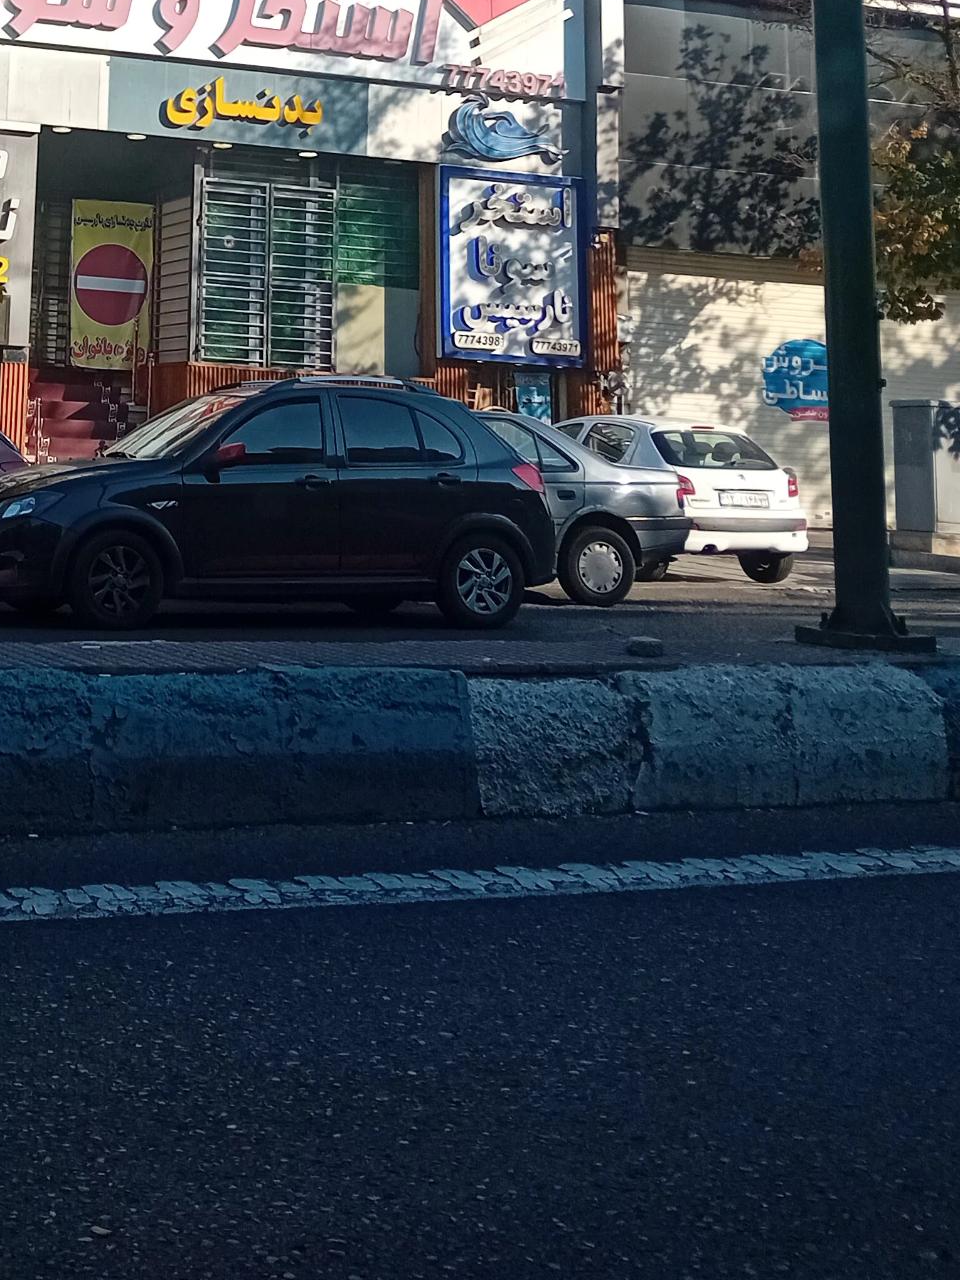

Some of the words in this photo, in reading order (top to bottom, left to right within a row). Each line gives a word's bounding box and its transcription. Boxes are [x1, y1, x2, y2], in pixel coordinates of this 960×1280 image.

[442, 64, 566, 96] 77743971
[162, 76, 324, 137] بدنسازی
[458, 184, 572, 231] استخر
[478, 235, 555, 294] سونا
[463, 289, 572, 331] نارسیس
[68, 334, 113, 361] بانوان
[113, 339, 147, 365] وژه
[534, 340, 579, 353] 77743971
[762, 344, 828, 377] روش
[762, 379, 828, 405] ساطی
